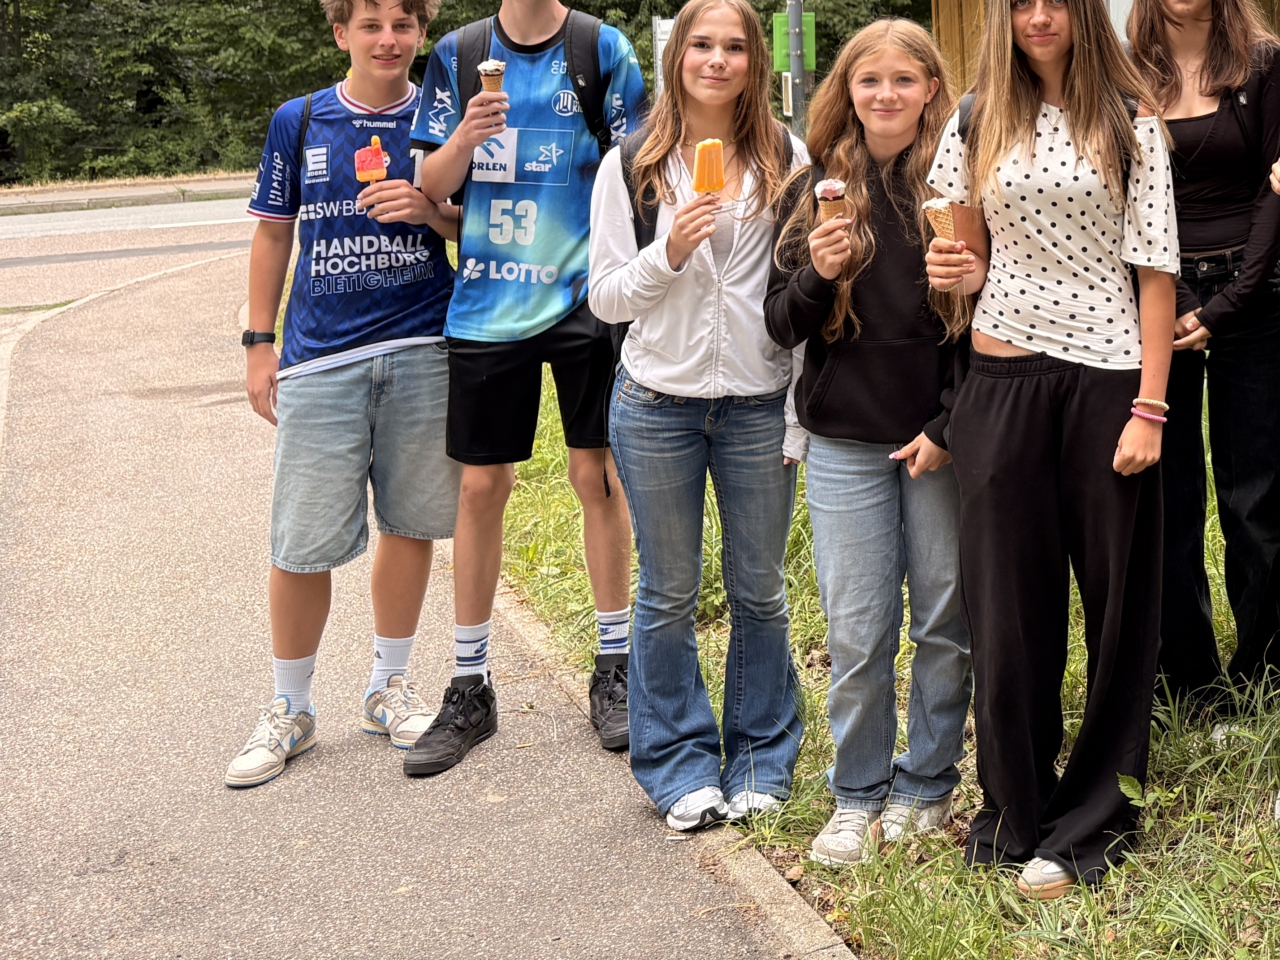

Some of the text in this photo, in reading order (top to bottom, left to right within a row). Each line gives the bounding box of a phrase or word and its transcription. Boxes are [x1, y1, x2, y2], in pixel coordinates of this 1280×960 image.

[363, 120, 397, 129] hummel
[523, 161, 552, 172] star
[488, 199, 538, 246] 53
[312, 234, 425, 259] HANDBALL
[311, 249, 430, 277] HOCHBURG
[488, 260, 559, 285] LOTTO
[310, 261, 434, 297] BIETIGHEIM
